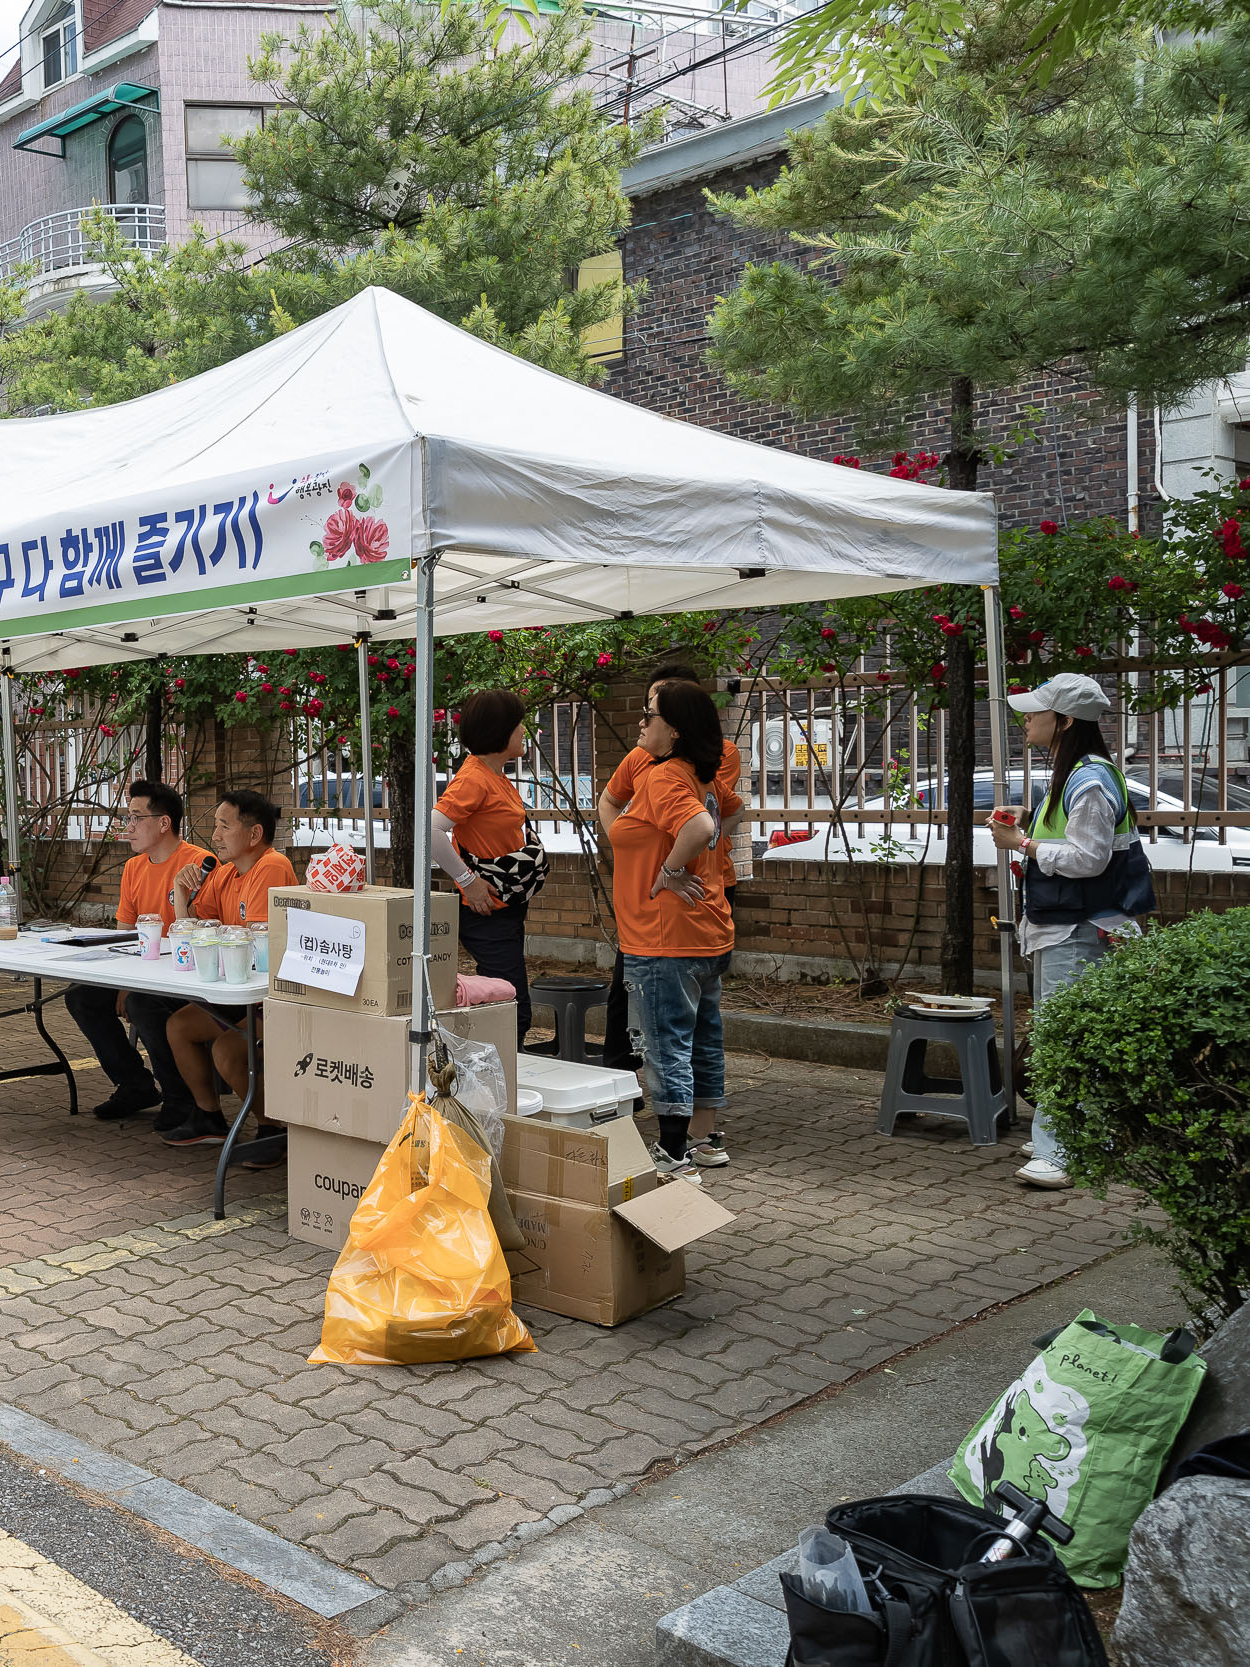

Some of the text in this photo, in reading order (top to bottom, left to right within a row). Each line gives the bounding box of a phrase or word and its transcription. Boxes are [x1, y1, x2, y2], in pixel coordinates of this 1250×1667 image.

[132, 489, 264, 586] 즐기기)
[299, 934, 353, 959] (컵)솜사탕
[314, 1055, 375, 1090] 로켓배송
[314, 1173, 365, 1201] coupan
[1059, 1353, 1118, 1387] planet!
